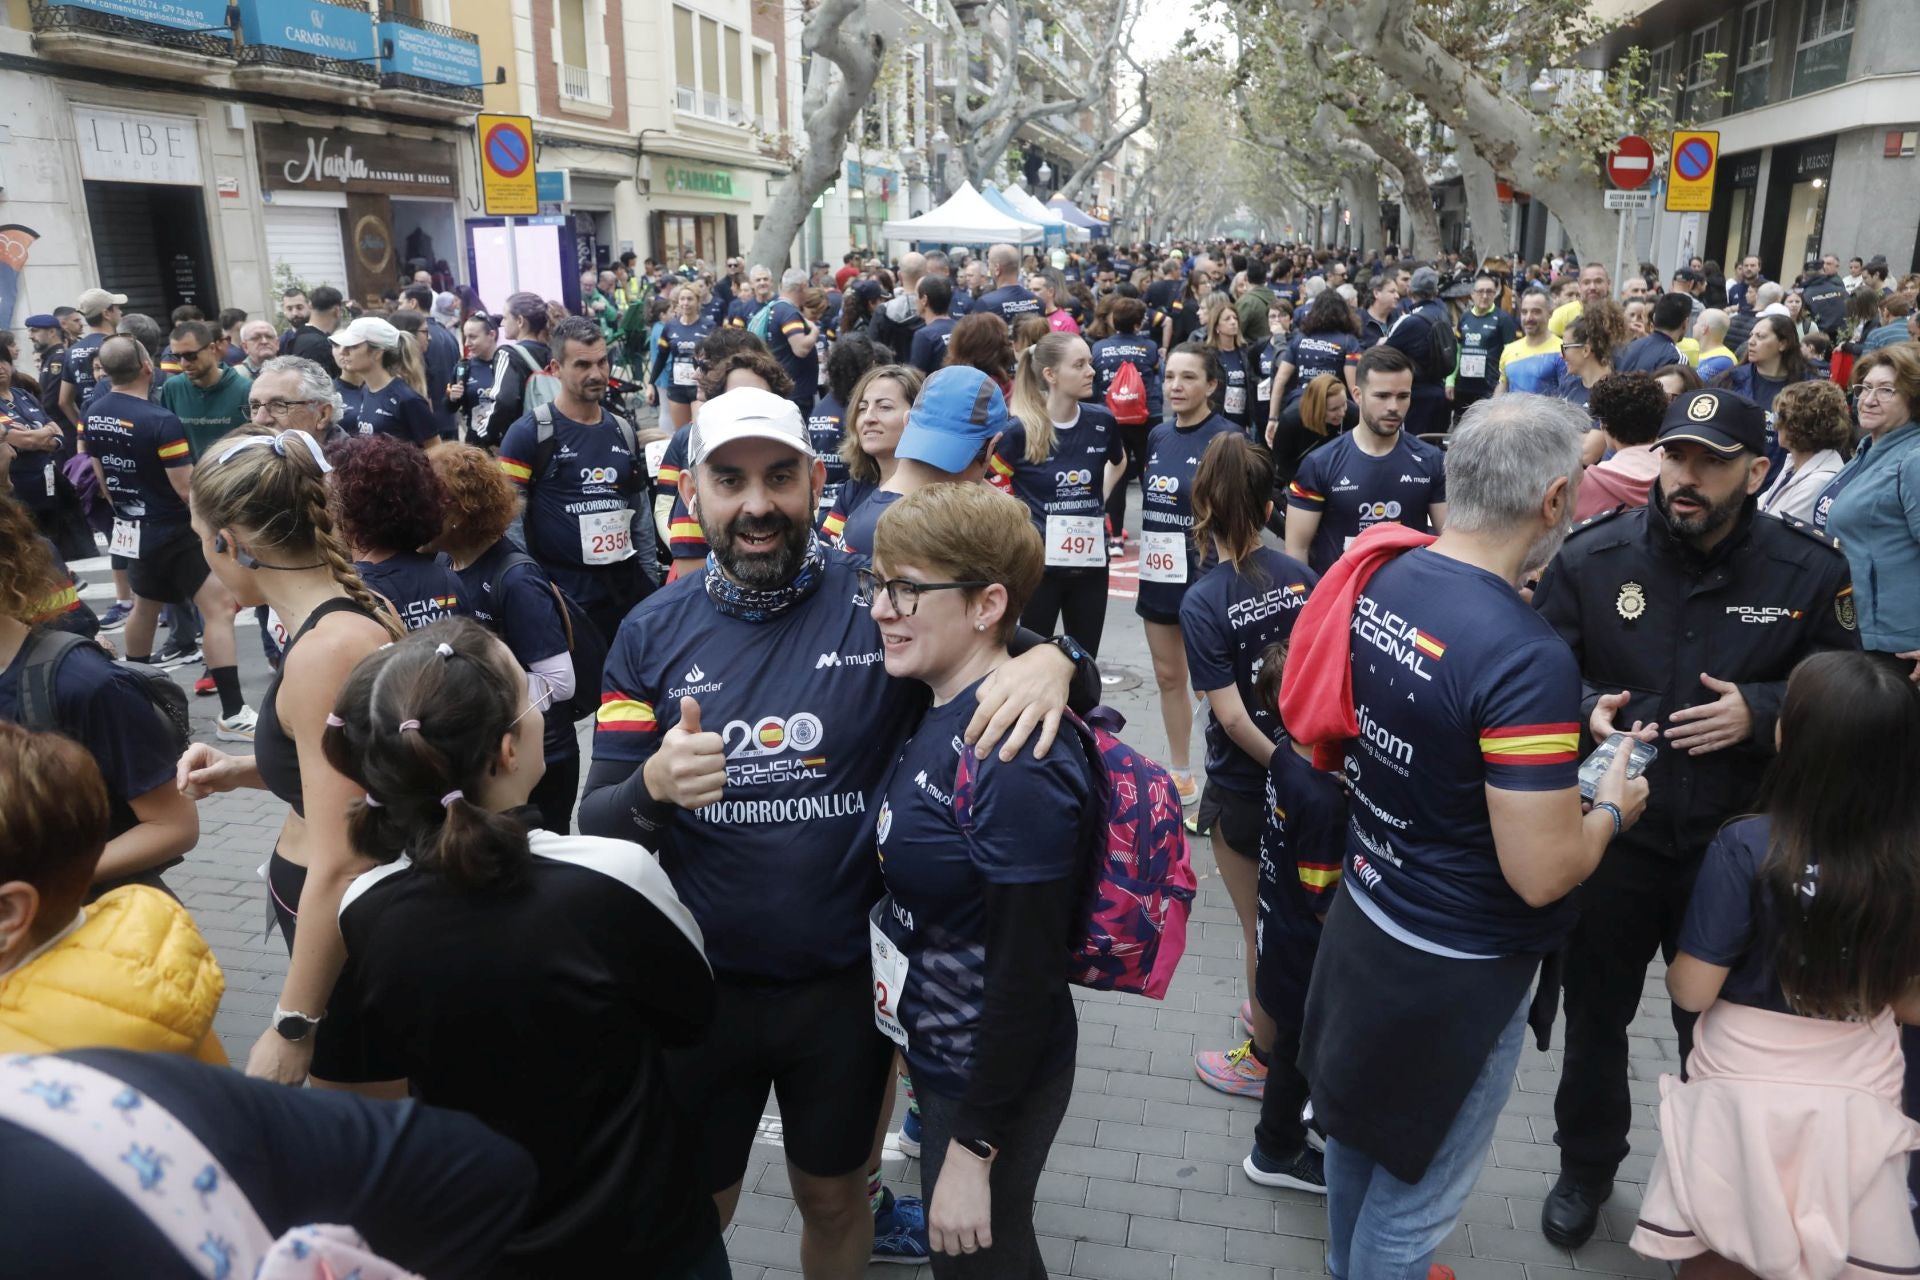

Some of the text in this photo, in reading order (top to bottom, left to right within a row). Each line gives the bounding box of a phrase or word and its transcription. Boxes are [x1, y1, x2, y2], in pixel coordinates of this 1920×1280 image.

[90, 118, 185, 158] LIBE
[284, 137, 450, 184] Naisha HANDMADE DESIGNS
[1004, 304, 1039, 313] NACIONAL
[88, 415, 120, 426] POLICIA
[580, 466, 618, 484] 200
[1055, 468, 1092, 487] 200
[1148, 474, 1179, 494] 200
[1056, 490, 1091, 498] NACIONAL
[1331, 484, 1359, 492] Santander
[1147, 496, 1177, 506] NACIONAL
[1358, 500, 1402, 520] 200
[592, 530, 628, 554] 2356
[1060, 536, 1095, 554] 497
[1145, 552, 1174, 570] 496
[1228, 585, 1294, 619] POLICIA
[1726, 606, 1791, 617] POLICIA
[1231, 597, 1309, 630] NACIONAL
[1355, 594, 1418, 648] POLICIA
[1742, 614, 1778, 624] CNP
[845, 649, 884, 666] mupol
[668, 682, 723, 698] Santander
[722, 712, 823, 760] 200
[726, 756, 805, 777] POLICIA
[727, 767, 827, 788] NACIONAL
[1355, 785, 1408, 830] ELECTRONICS
